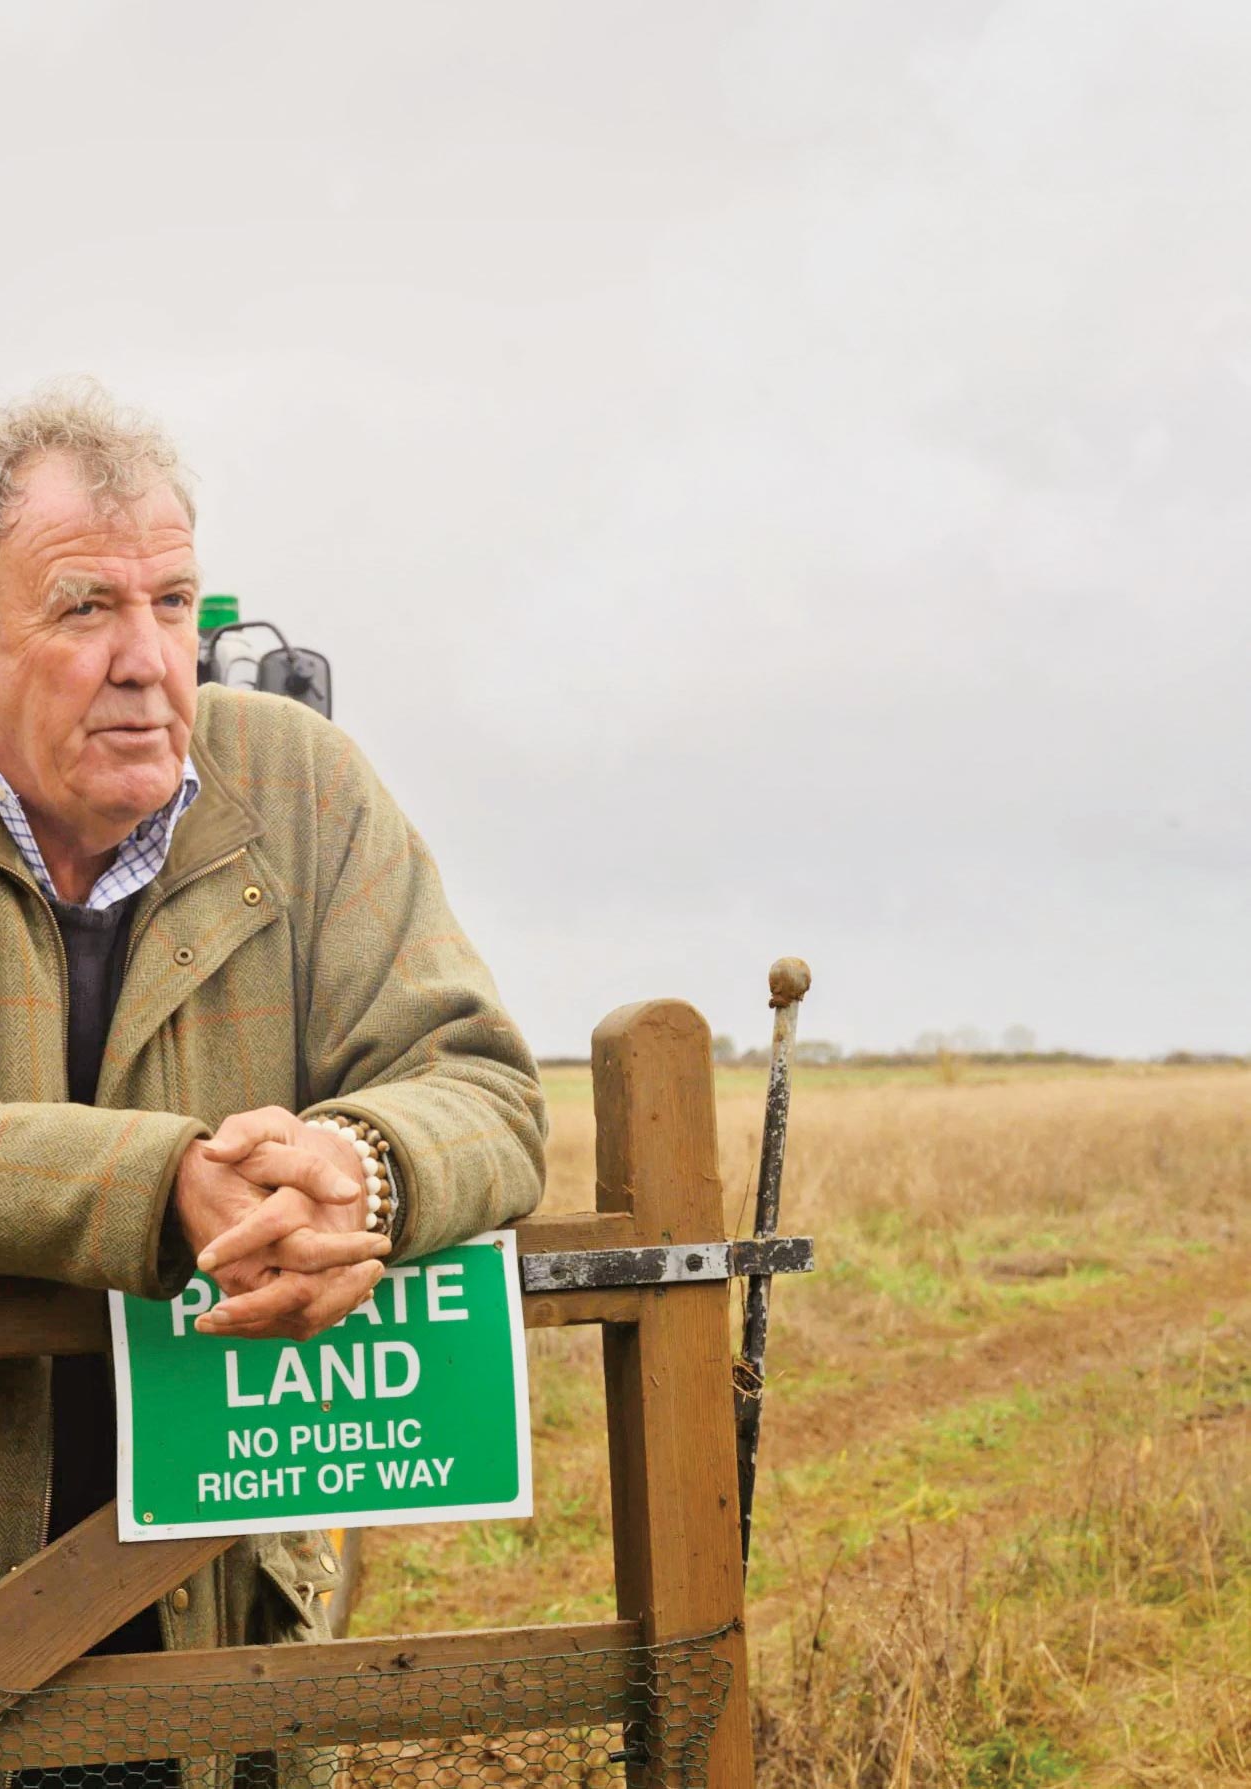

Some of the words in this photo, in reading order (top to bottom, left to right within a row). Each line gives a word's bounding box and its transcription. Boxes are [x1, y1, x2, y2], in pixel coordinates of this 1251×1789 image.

[225, 1341, 421, 1408] LAND
[228, 1427, 279, 1459] NO
[290, 1418, 422, 1455] PUBLIC
[198, 1466, 307, 1503] RIGHT
[317, 1462, 366, 1494] OF
[376, 1457, 456, 1490] WAY
